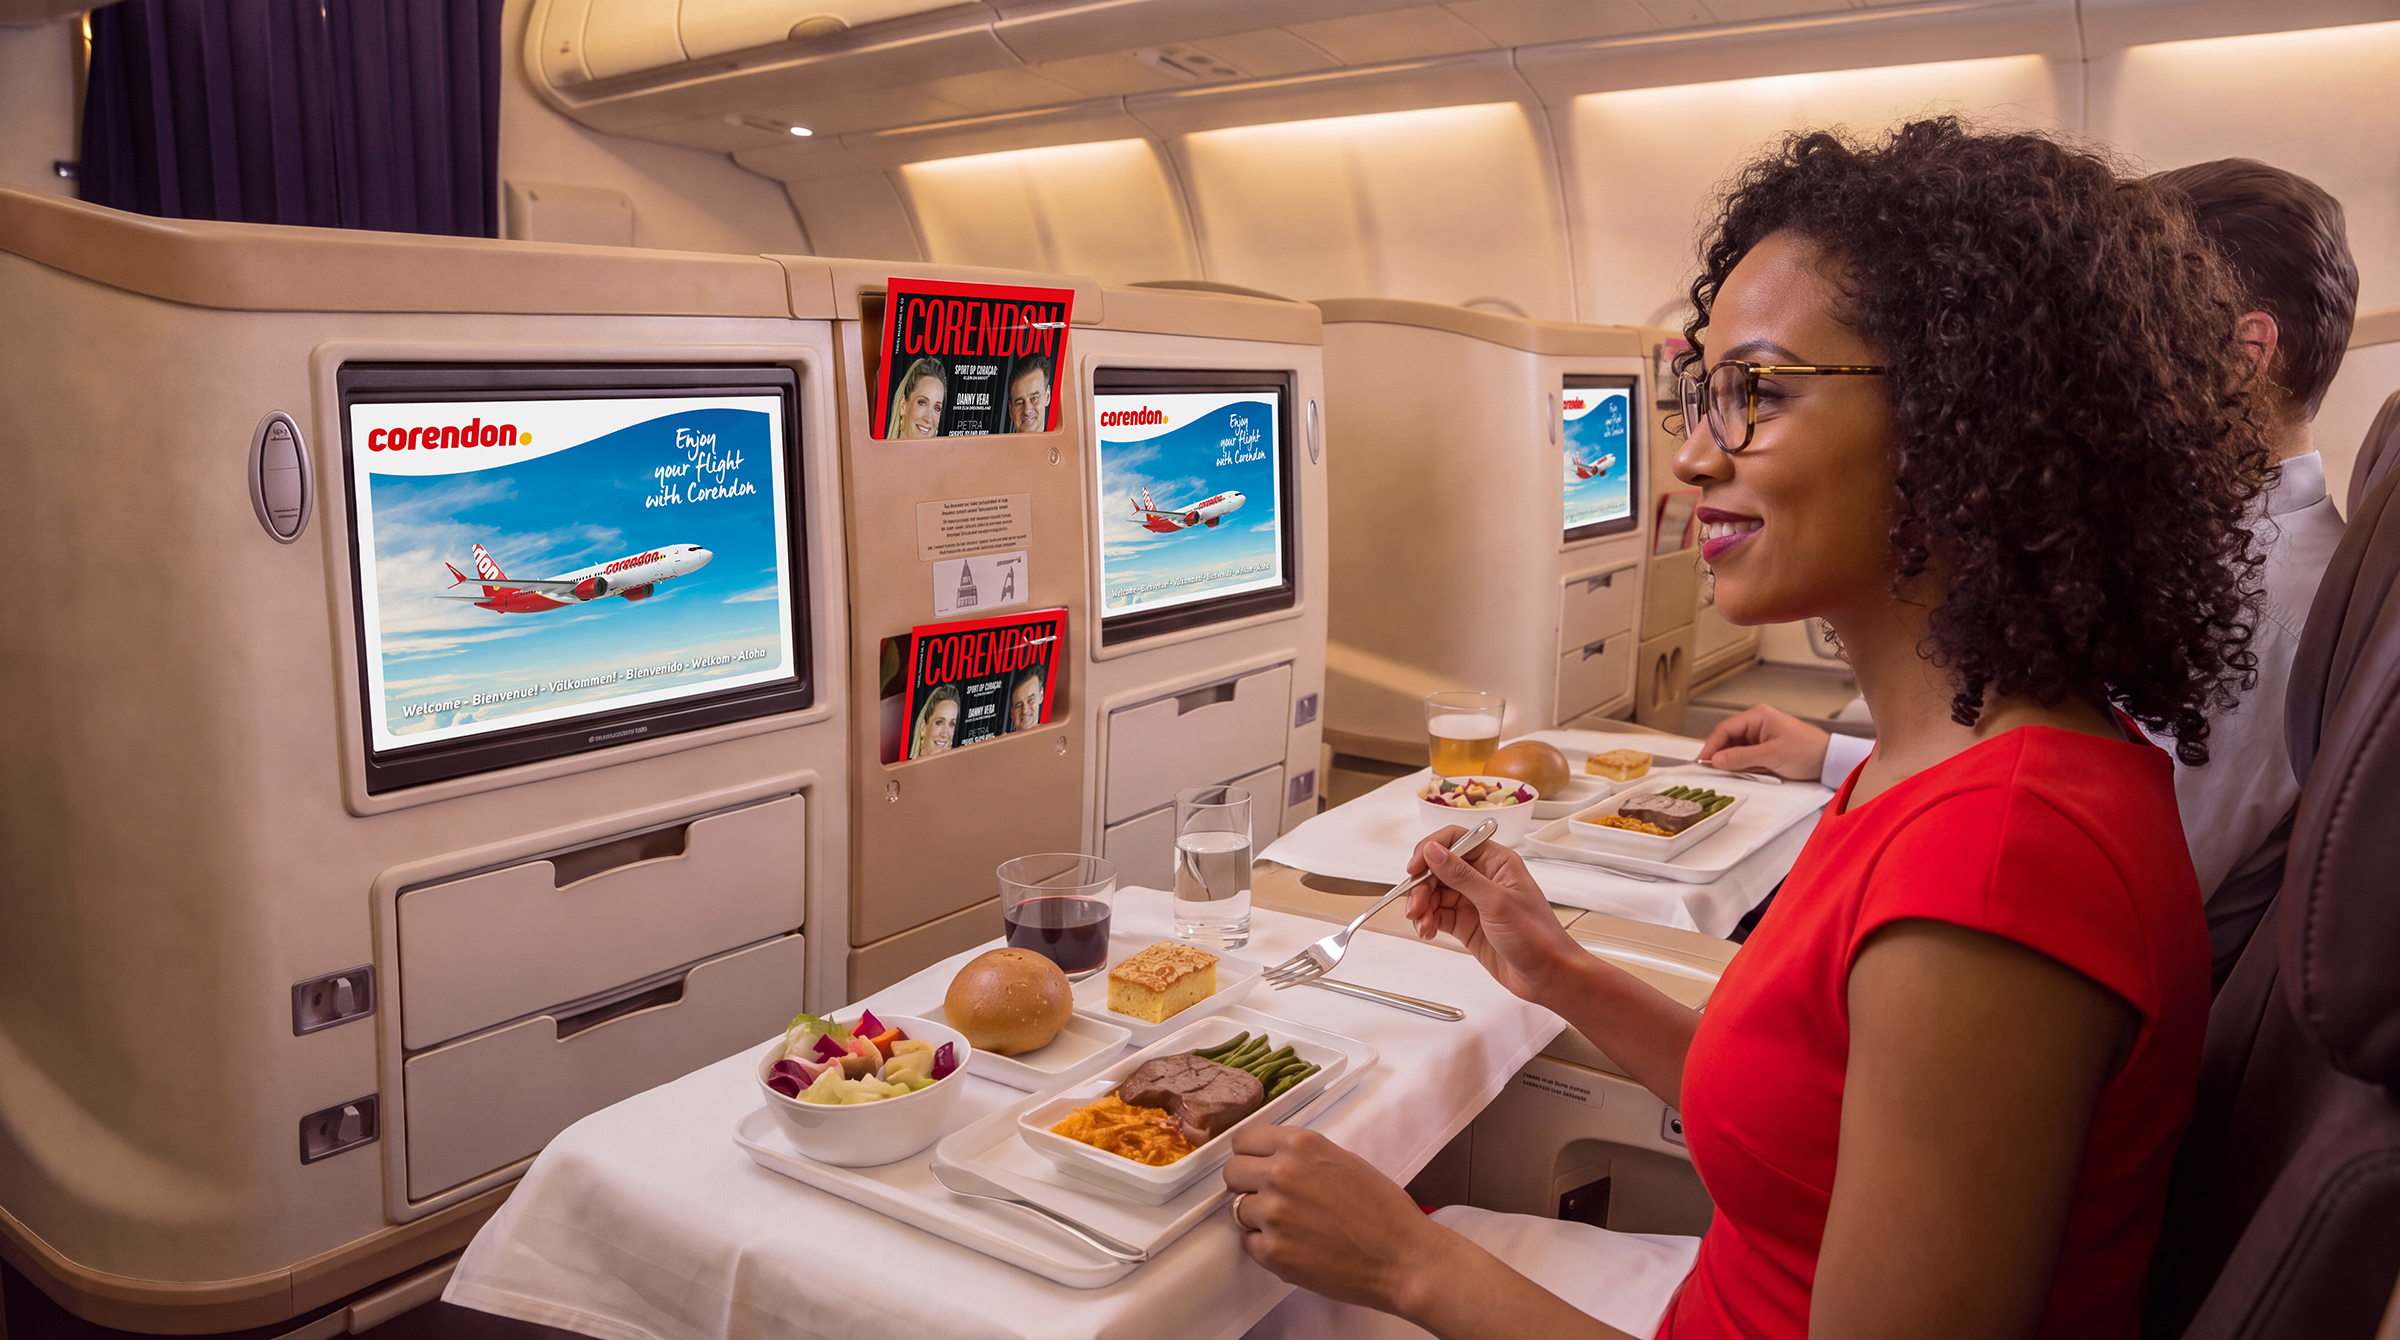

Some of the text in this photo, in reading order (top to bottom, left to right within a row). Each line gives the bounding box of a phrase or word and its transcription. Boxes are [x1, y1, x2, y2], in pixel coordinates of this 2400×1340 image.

[904, 298, 1058, 358] CORENDON
[954, 364, 970, 375] SPORT
[970, 364, 976, 375] OP
[956, 393, 989, 405] DANNY VERA
[957, 420, 982, 430] PETRA
[1230, 414, 1248, 436] Enjoy
[676, 428, 716, 461] Enjoy
[1220, 429, 1261, 453] your flight
[1216, 448, 1266, 466] with Corendon
[654, 450, 744, 488] your flight
[645, 478, 757, 508] with Corendon
[1112, 586, 1137, 598] Welcome
[925, 624, 1050, 686] CORENDON
[402, 699, 461, 718] Welcome
[472, 684, 538, 706] Bienvenue!
[548, 672, 616, 693] Välkommen!
[626, 662, 683, 680] Bienvenido
[691, 654, 730, 670] Welkom
[738, 648, 766, 662] Aloha
[967, 684, 979, 694] SPORT
[968, 706, 983, 718] DANNY
[984, 704, 995, 714] VERA
